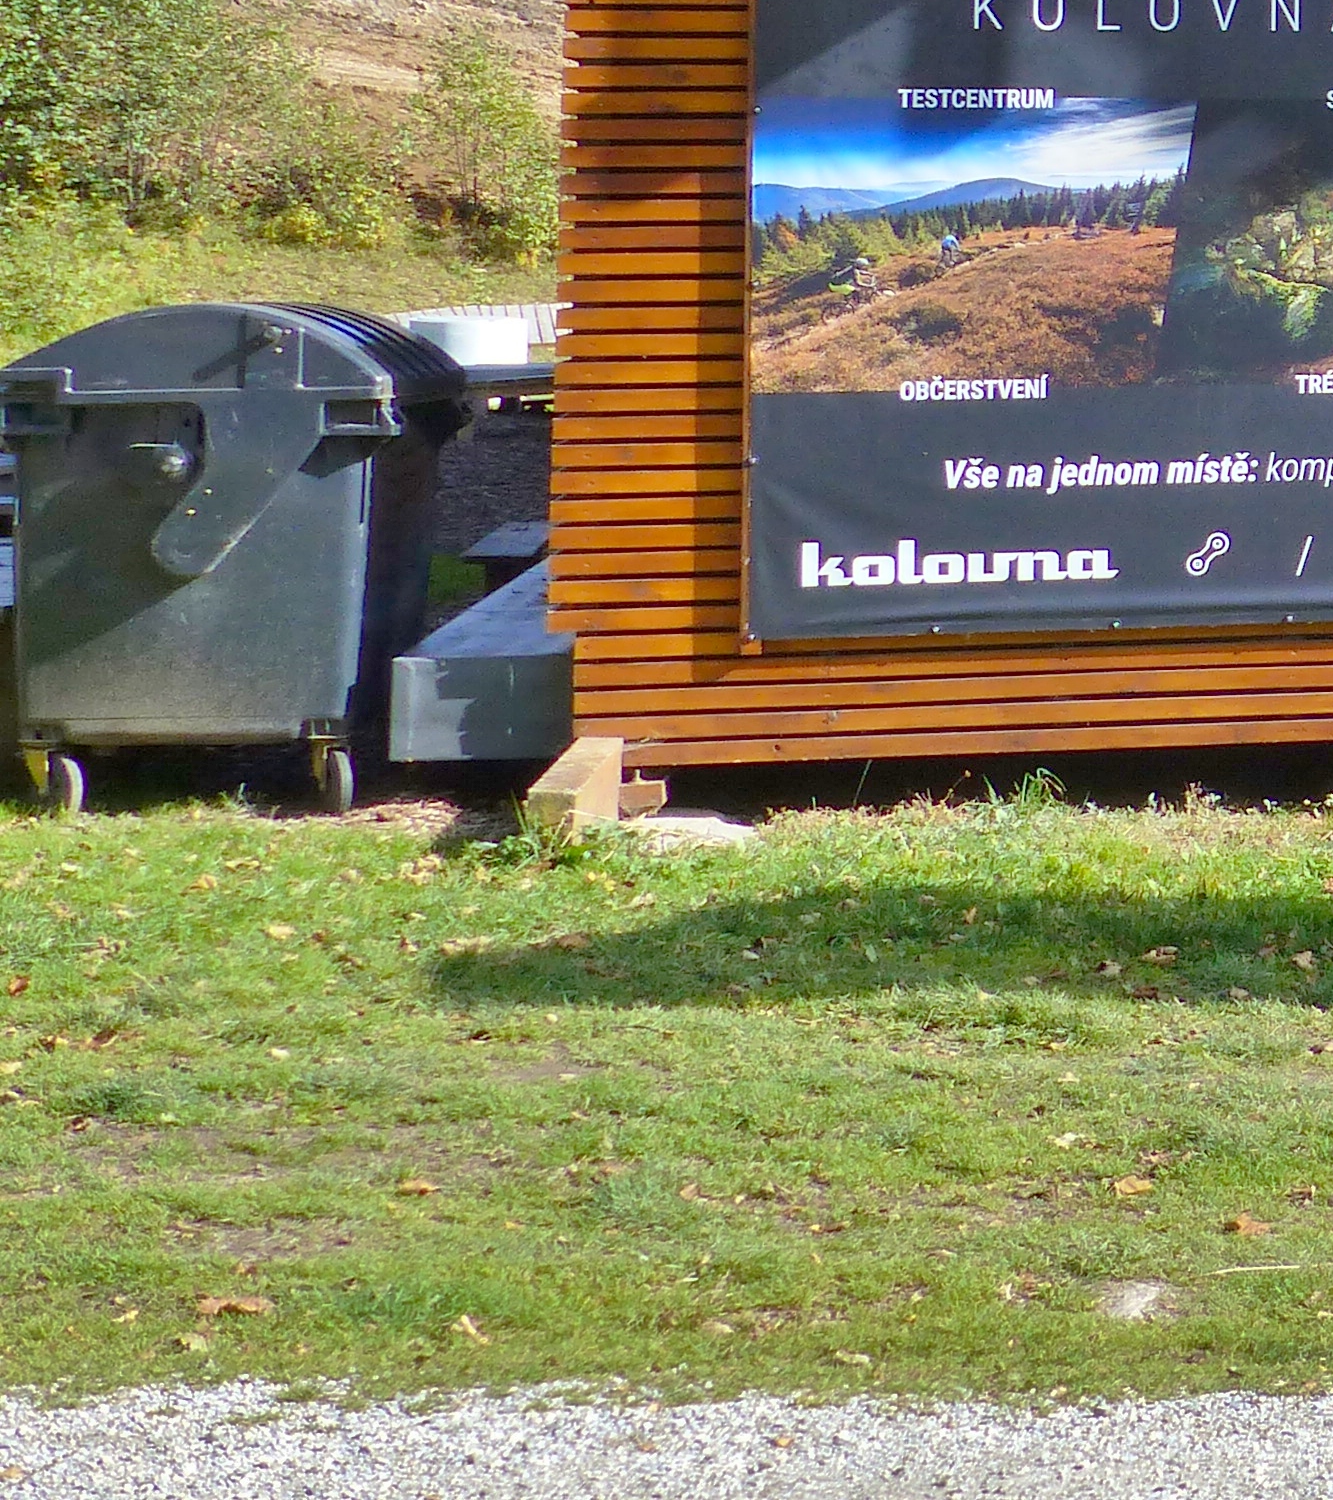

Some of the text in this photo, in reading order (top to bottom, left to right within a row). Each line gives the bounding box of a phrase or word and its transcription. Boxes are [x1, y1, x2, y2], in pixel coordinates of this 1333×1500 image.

[896, 87, 1055, 110] TESTCENTRUM
[898, 374, 1049, 402] OBČERSTVENÍ
[943, 457, 1000, 490] Vše
[1005, 463, 1043, 489] na
[1045, 455, 1160, 496] jednom
[1165, 452, 1259, 486] místě:
[800, 538, 1121, 589] kolovna
